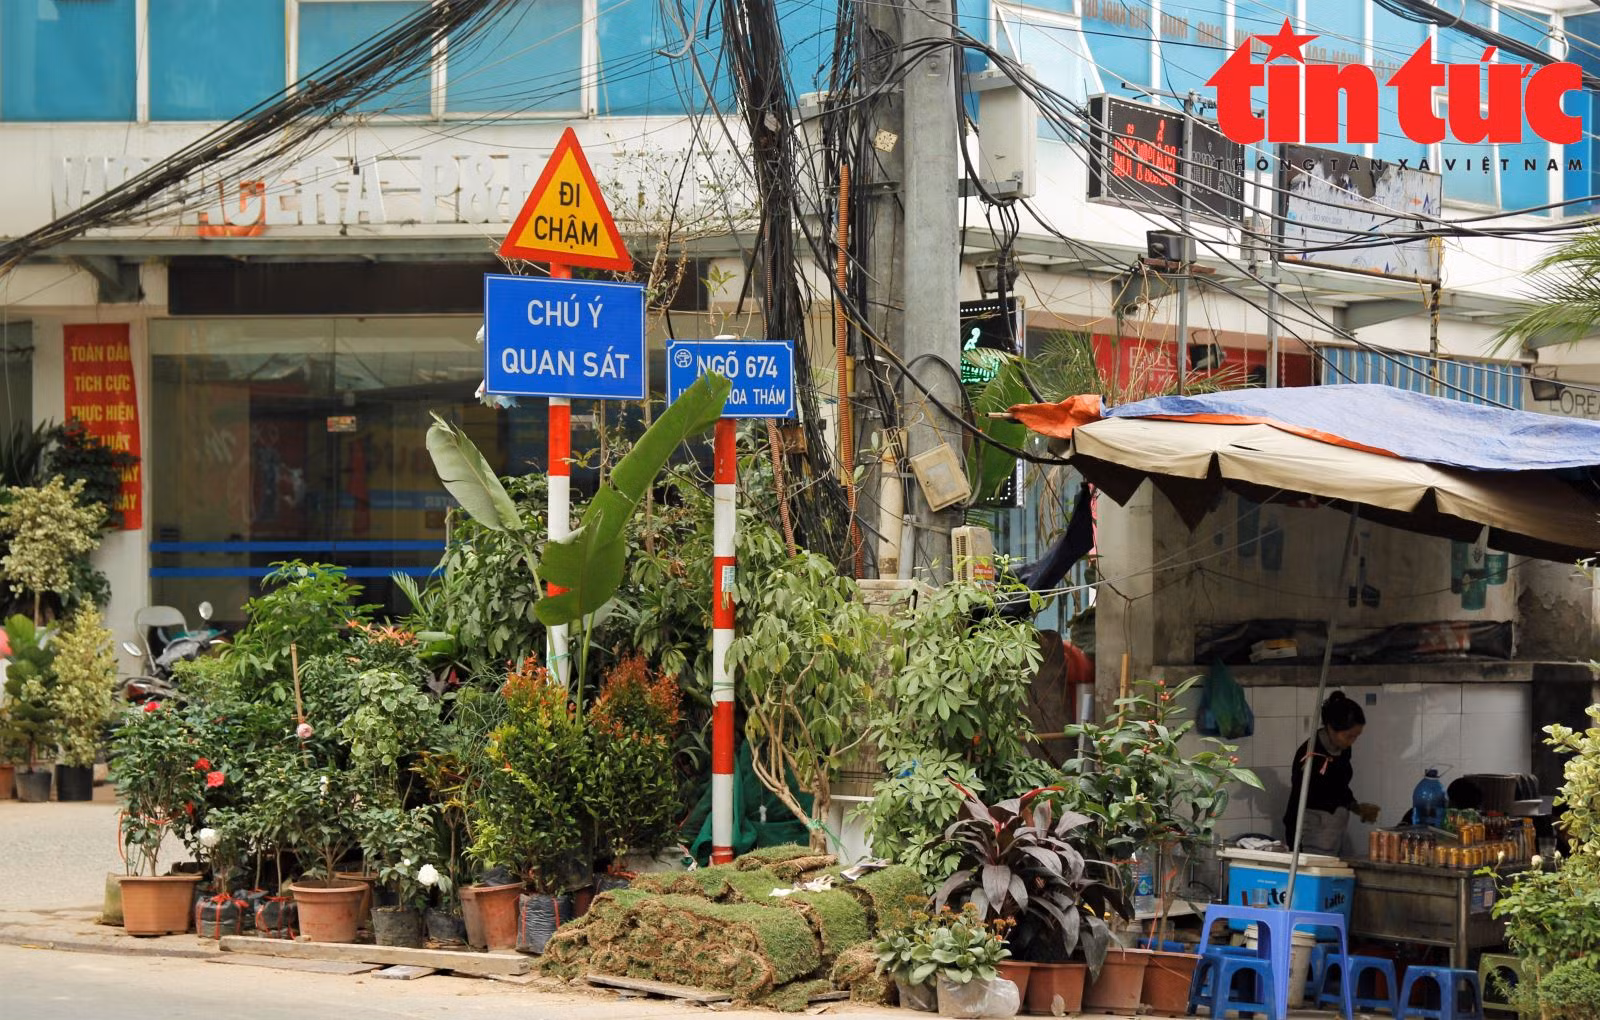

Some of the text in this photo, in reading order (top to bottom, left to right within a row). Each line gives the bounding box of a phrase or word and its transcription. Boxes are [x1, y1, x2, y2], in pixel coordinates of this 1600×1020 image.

[558, 181, 580, 206] ĐI
[534, 214, 598, 249] CHẬM
[527, 293, 604, 329] CHÚ Ý
[71, 342, 103, 362] TOÀN
[501, 345, 630, 379] QUAN SÁT
[696, 350, 778, 379] NGÕ 674
[74, 372, 131, 395] TÍCH CỰC
[752, 384, 786, 405] THÁM
[71, 401, 134, 425] THỰC HIỆN
